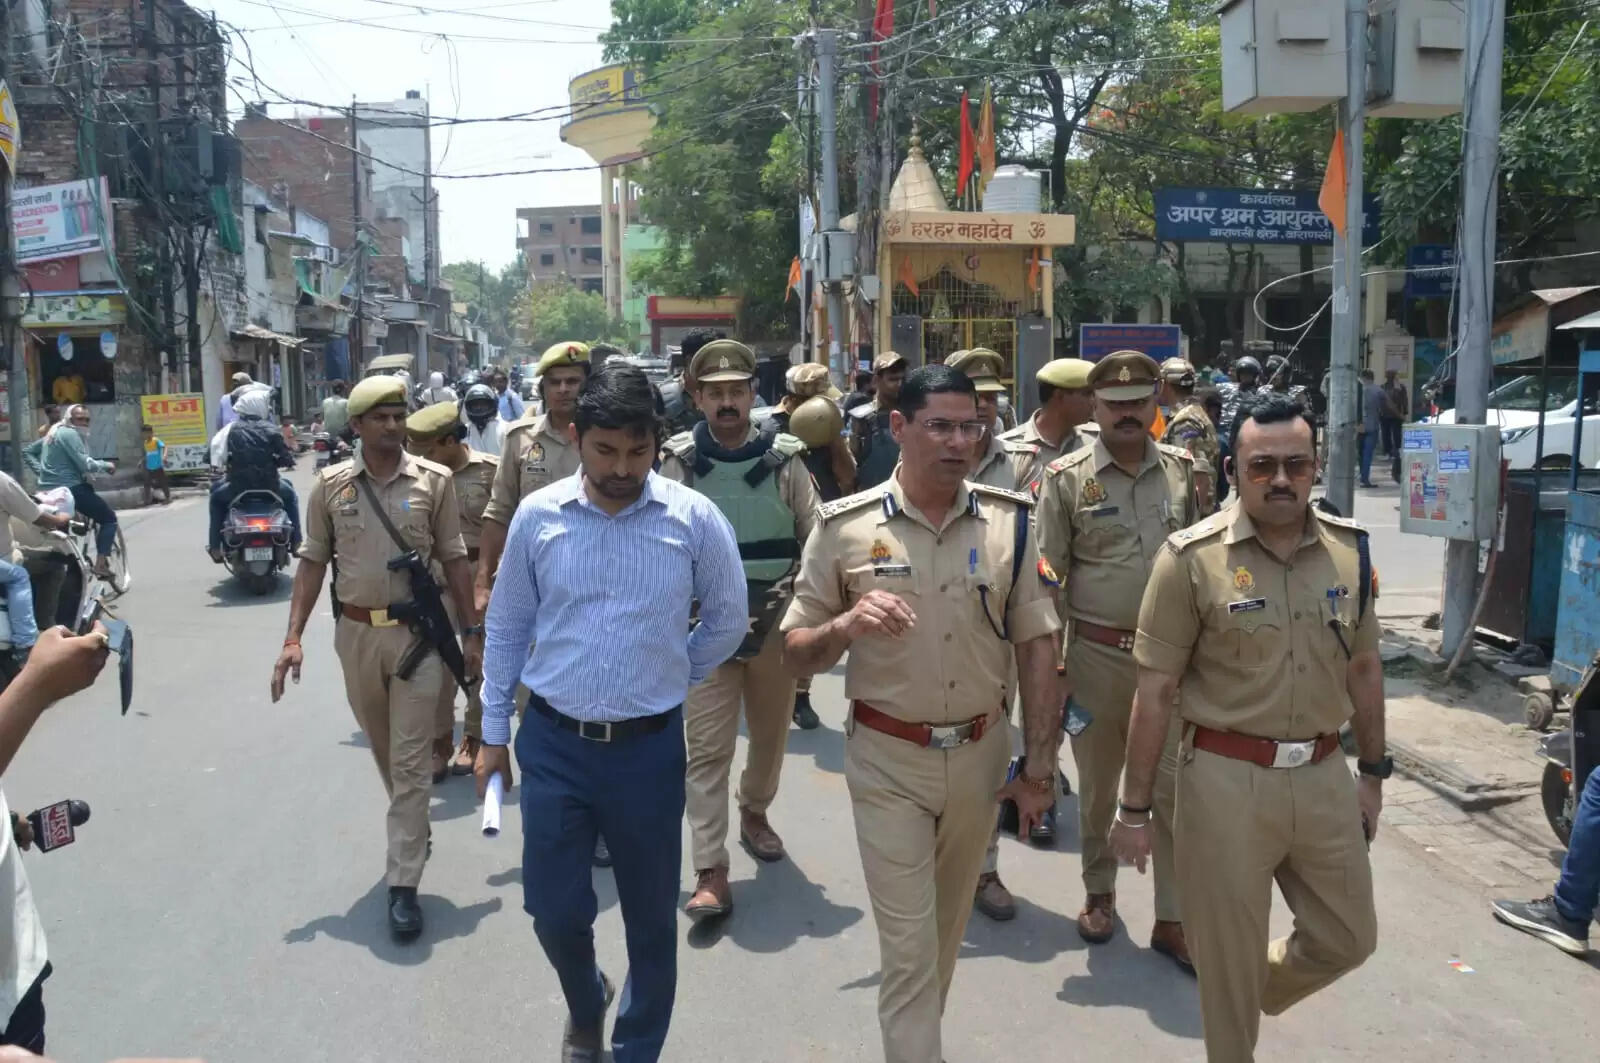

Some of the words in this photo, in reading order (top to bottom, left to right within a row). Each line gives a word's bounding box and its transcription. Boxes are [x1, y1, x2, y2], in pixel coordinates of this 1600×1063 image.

[1239, 192, 1296, 207] कार्यालय
[1167, 206, 1217, 225] अपर
[1220, 207, 1259, 227] श्रम
[957, 218, 1013, 241] महादेव
[143, 398, 200, 415] राज
